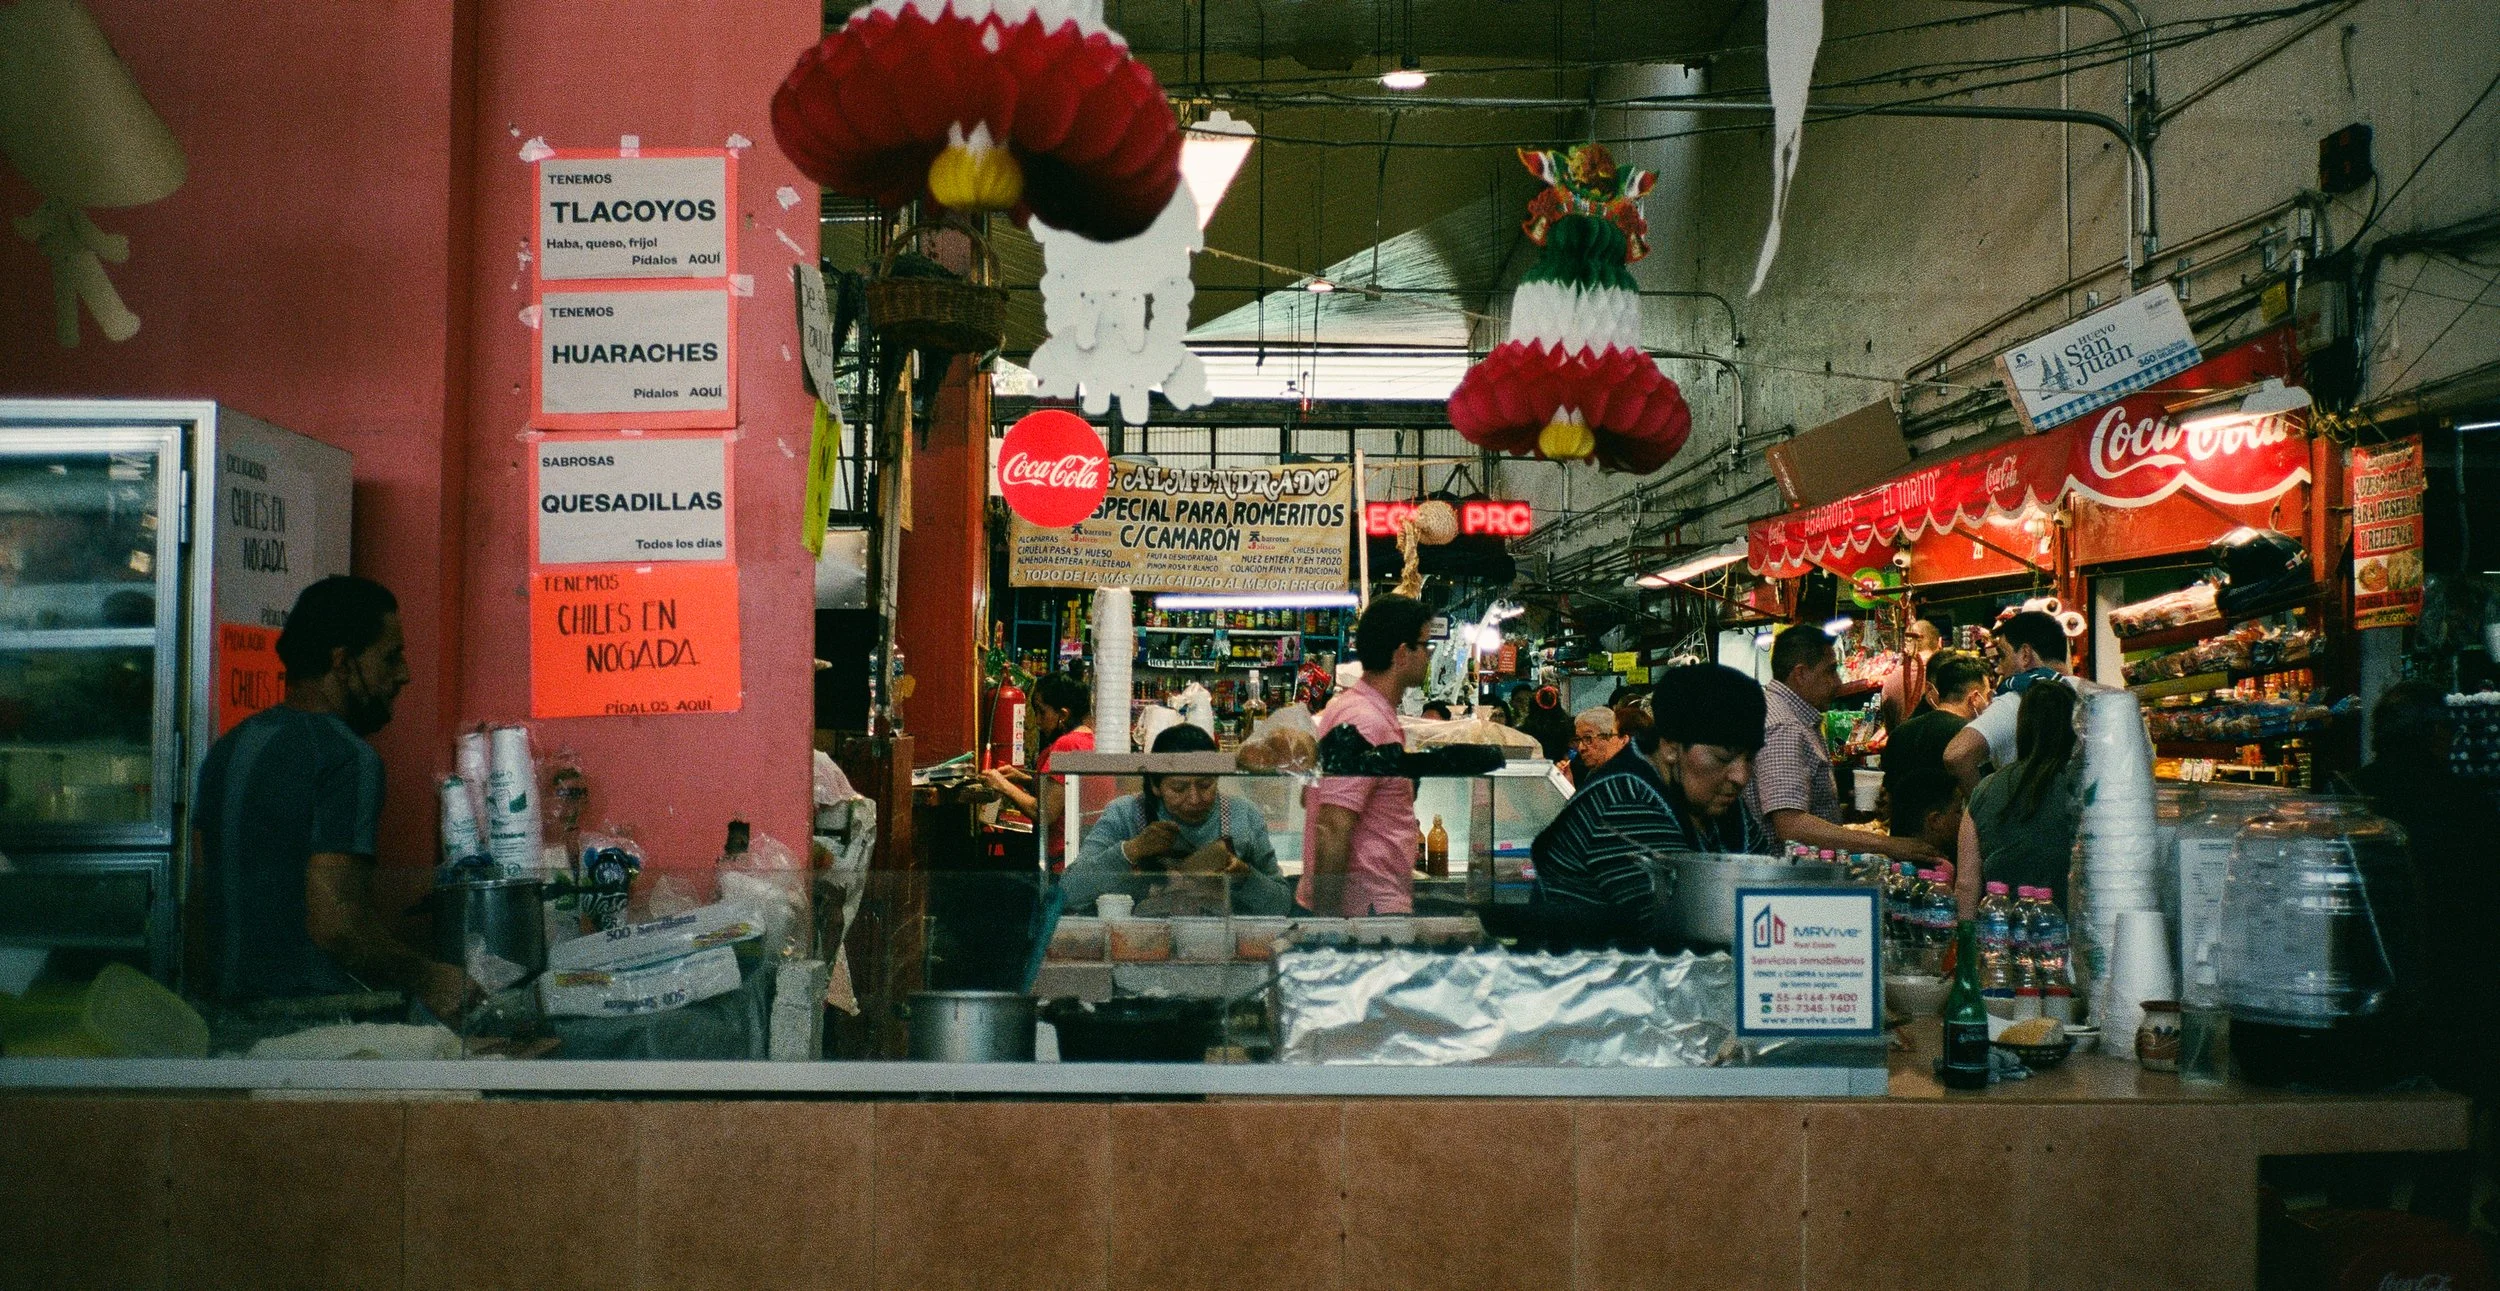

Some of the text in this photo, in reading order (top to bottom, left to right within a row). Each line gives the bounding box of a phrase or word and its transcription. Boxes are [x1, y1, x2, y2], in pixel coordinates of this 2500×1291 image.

[548, 173, 612, 185] TENEMOS
[550, 199, 717, 224] TLACOYOS
[546, 236, 657, 250] Haba, queso, frijol
[632, 252, 721, 265] Pídalos AQUÍ
[549, 306, 614, 318] TENEMOS
[551, 342, 718, 364] HUARACHES
[2064, 334, 2115, 368] San
[2075, 342, 2135, 386] Juan
[2137, 353, 2156, 368] 360
[633, 386, 722, 399] Pídalos AQUÍ
[542, 456, 614, 468] SABROSAS
[1003, 452, 1106, 489] Coca-Cola
[541, 491, 723, 514] QUESADILLAS
[231, 487, 286, 534] CHILES EN
[1091, 496, 1345, 527] SPECIAL PARA ROMERITOS
[636, 538, 723, 551] Todos los días
[1018, 535, 1059, 544] ALCAPARRAS
[243, 536, 289, 575] NOGADA
[1017, 546, 1113, 558] CIRUELA PASA S/ HUESO
[1146, 552, 1168, 560] FRUTA
[1292, 546, 1342, 555] CHILES LARGOS
[1017, 555, 1131, 569] ALMENDRA ENTERA Y FILETEADA
[1241, 555, 1343, 566] NUEZ ENTERA Y EN TROZO
[1167, 563, 1186, 571] ROSA
[1192, 564, 1219, 573] BLANCO
[1268, 565, 1287, 574] FINA
[1287, 566, 1293, 574] Y
[1294, 566, 1342, 576] TRADICIONAL
[543, 574, 619, 593] TENEMOS
[1024, 569, 1062, 581] TODO
[1063, 571, 1083, 582] DE
[1083, 572, 1101, 583] LA
[1131, 573, 1164, 585] ALTA
[1165, 574, 1226, 588] CALIDAD
[1224, 576, 1242, 589] AL
[1242, 577, 1288, 590] MEJOR
[557, 599, 677, 636] CHILES EN
[585, 638, 700, 674] NOGADA
[1752, 955, 1797, 966] Servicios
[1776, 993, 1858, 1002] 55-4164-9400
[1776, 1004, 1857, 1013] 55-7345-1601
[1761, 1015, 1857, 1024] www.mrvive.com
